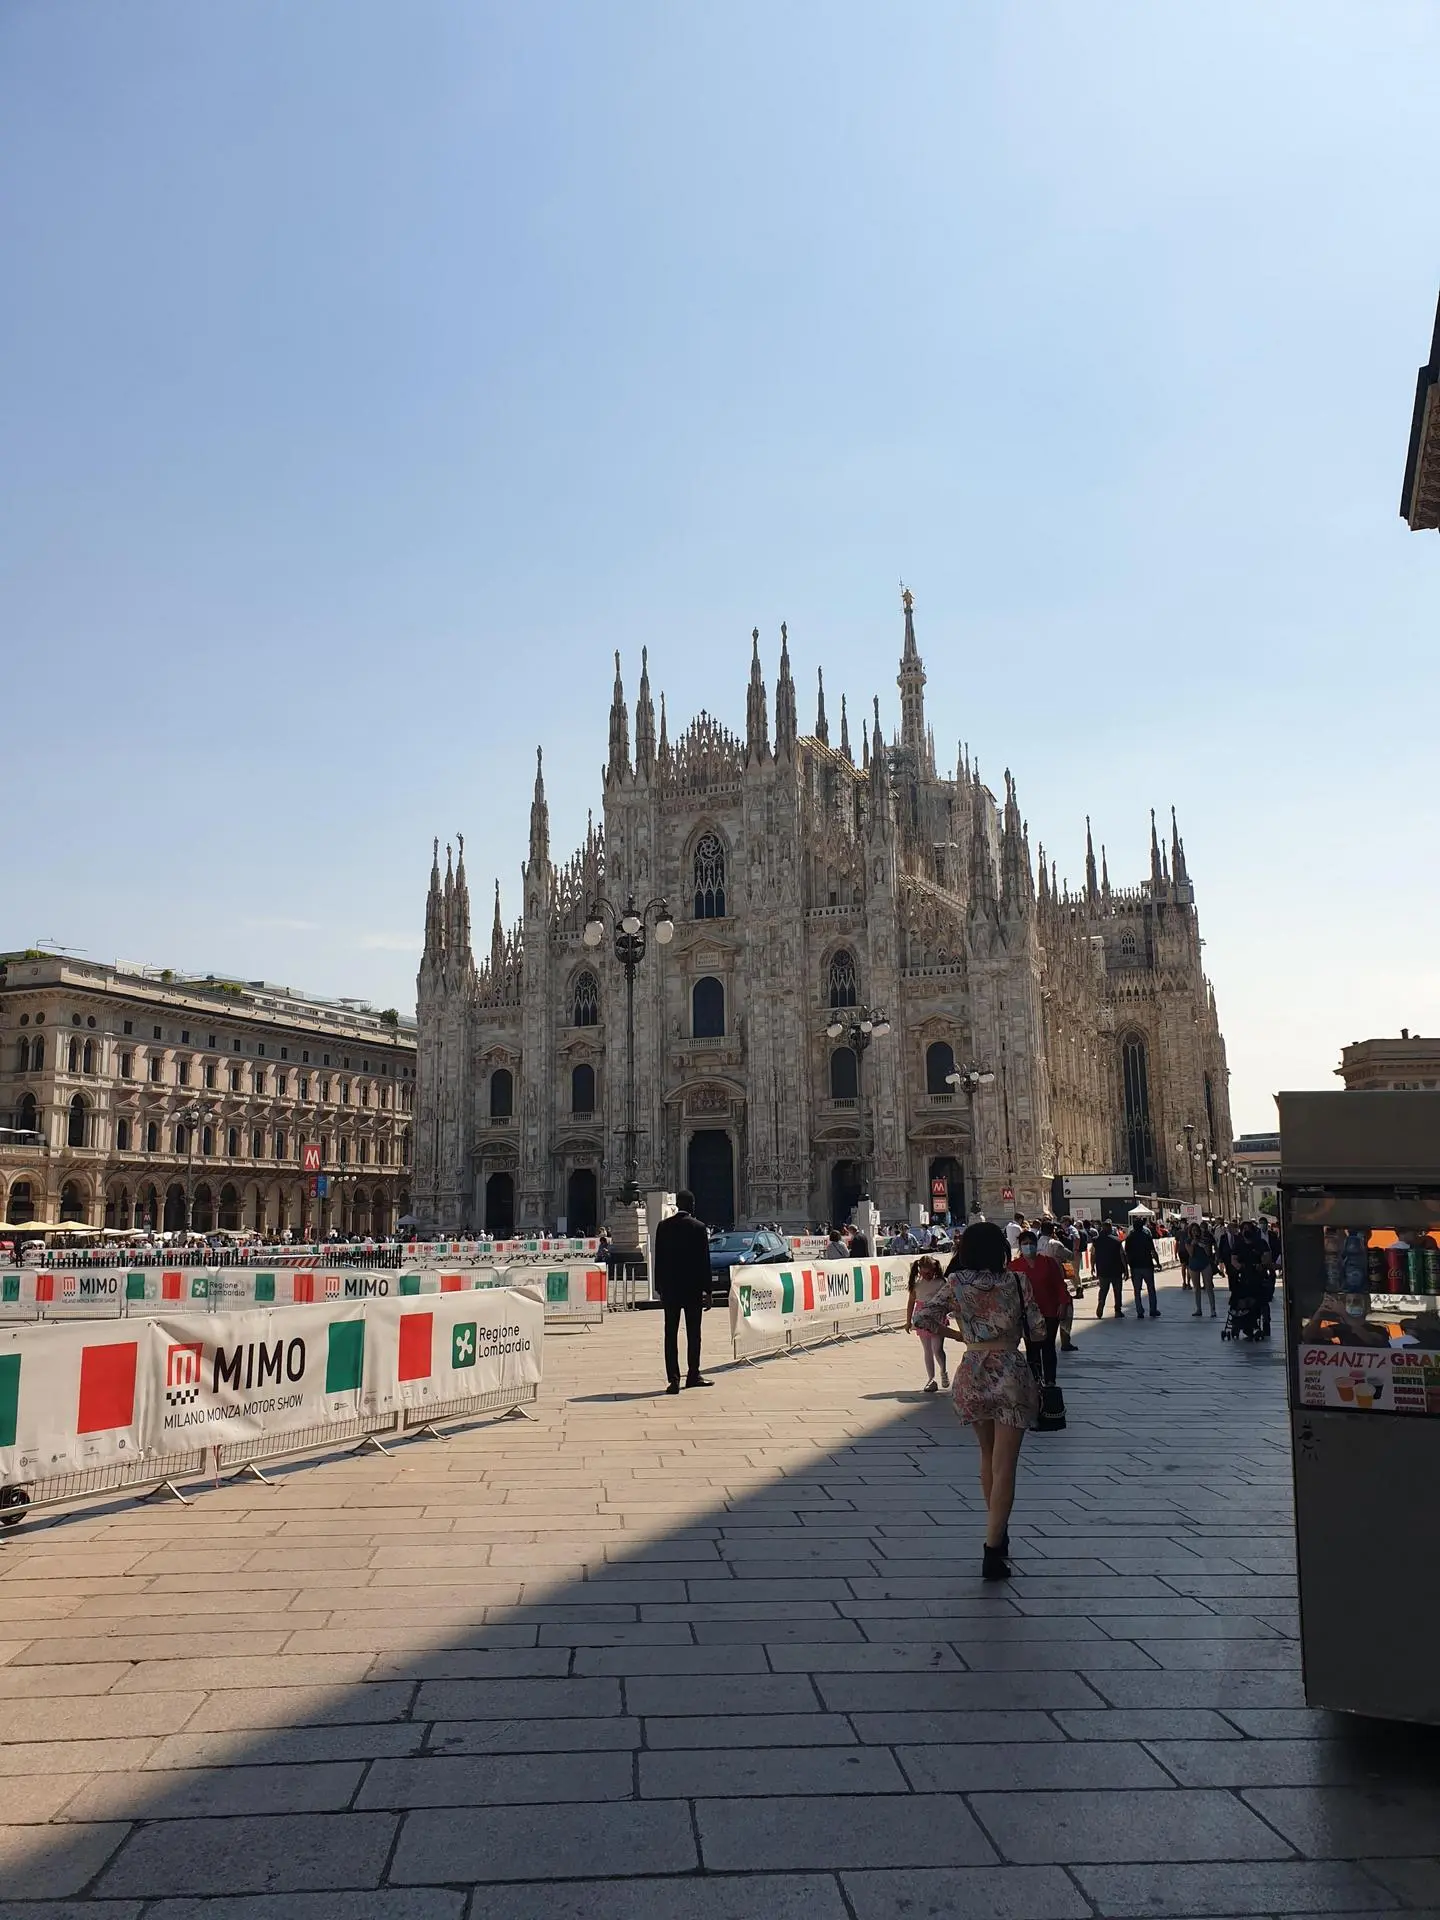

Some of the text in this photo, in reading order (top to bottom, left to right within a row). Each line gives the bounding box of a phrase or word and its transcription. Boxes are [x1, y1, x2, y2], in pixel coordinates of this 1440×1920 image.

[305, 1149, 320, 1169] M
[933, 1182, 945, 1192] M
[1002, 1189, 1013, 1199] M
[79, 1278, 118, 1294] MIMO
[209, 1281, 239, 1290] Regione
[209, 1289, 245, 1297] Lombardia
[344, 1279, 389, 1297] MIMO
[827, 1273, 850, 1297] MIMO
[751, 1288, 773, 1302] Regione
[751, 1299, 777, 1312] Lombardia
[479, 1325, 520, 1342] Regione
[478, 1338, 531, 1359] Lombardia
[212, 1337, 306, 1393] MIMO
[164, 1393, 304, 1430] MILANO MONZA MOTOR SHOW
